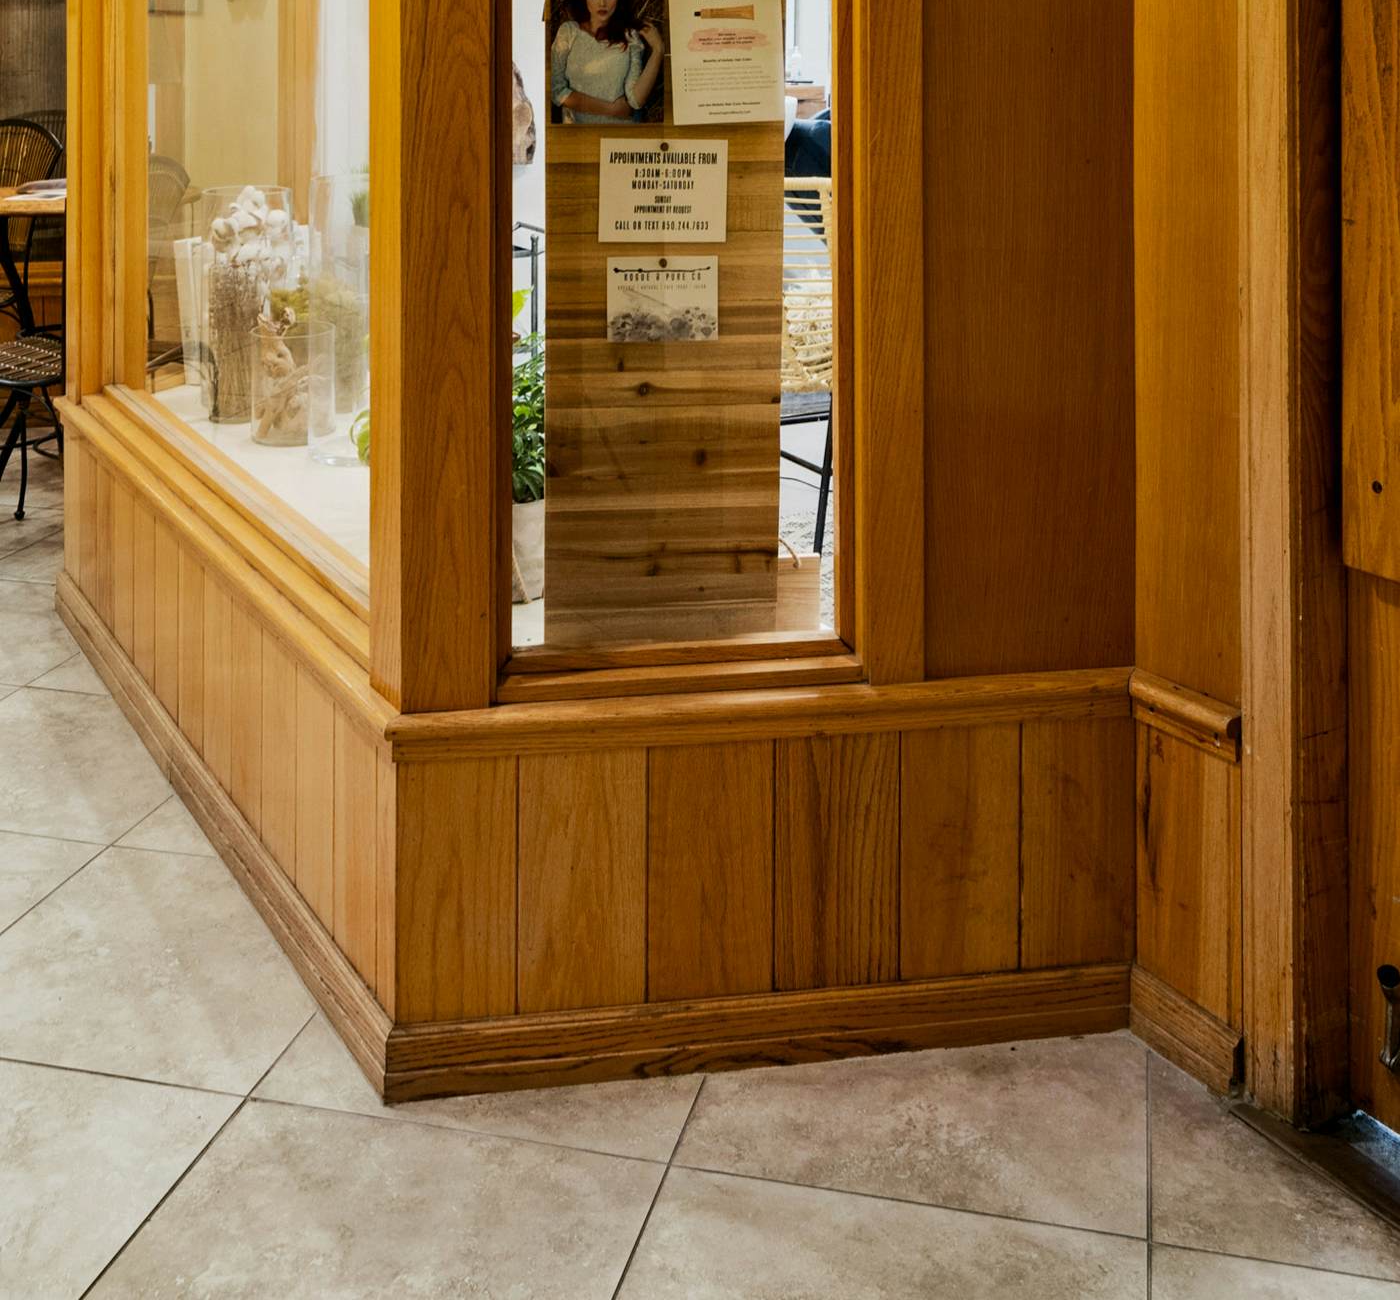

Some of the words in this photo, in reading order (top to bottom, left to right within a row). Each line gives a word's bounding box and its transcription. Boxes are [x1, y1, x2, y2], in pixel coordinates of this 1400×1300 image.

[609, 151, 661, 165] APPOINTMENTS
[662, 152, 696, 165] AVAILABLE
[698, 152, 718, 165] FROM
[631, 180, 694, 190] MONDAY-SATURDAY
[654, 195, 672, 204] SUNDAY
[633, 205, 665, 214] APPOINTMENT
[665, 205, 672, 214] BY
[672, 205, 692, 214] REQUEST
[614, 220, 630, 231] CALL
[632, 220, 642, 231] OR
[644, 220, 659, 231] TEXT
[665, 272, 686, 281] PURE
